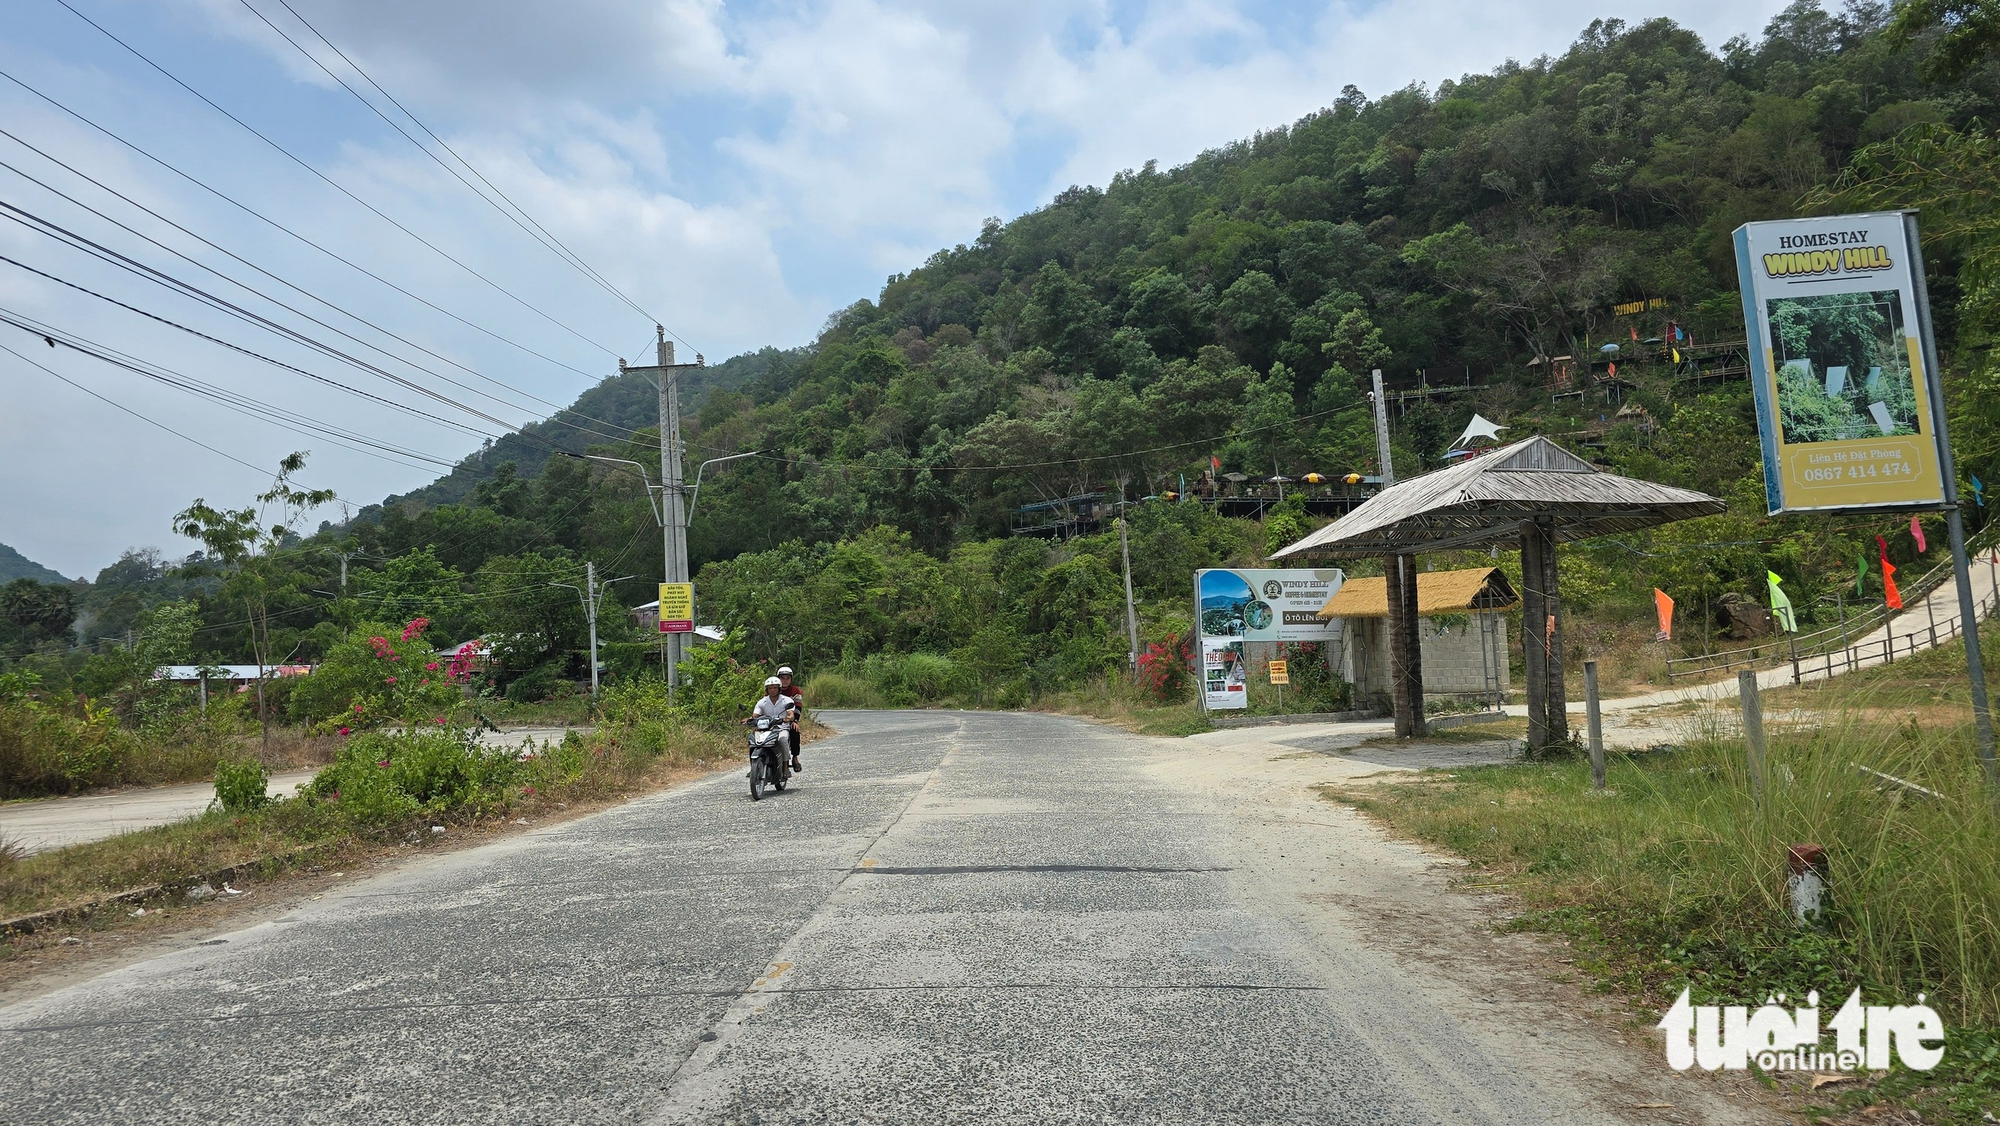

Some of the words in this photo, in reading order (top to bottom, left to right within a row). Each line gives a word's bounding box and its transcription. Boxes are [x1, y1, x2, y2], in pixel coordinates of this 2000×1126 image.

[1779, 230, 1869, 249] HOMESTAY
[1763, 248, 1841, 278] WINDY
[1843, 246, 1893, 272] HILL
[1613, 301, 1645, 316] WINDY
[1809, 453, 1831, 463] Liên
[1833, 452, 1847, 463] Hệ
[1850, 451, 1868, 462] Đặt
[1870, 449, 1902, 459] Phòng
[1804, 466, 1843, 482] 0867
[1848, 465, 1877, 478] 414
[1881, 462, 1911, 476] 474
[1206, 652, 1223, 662] THEO
